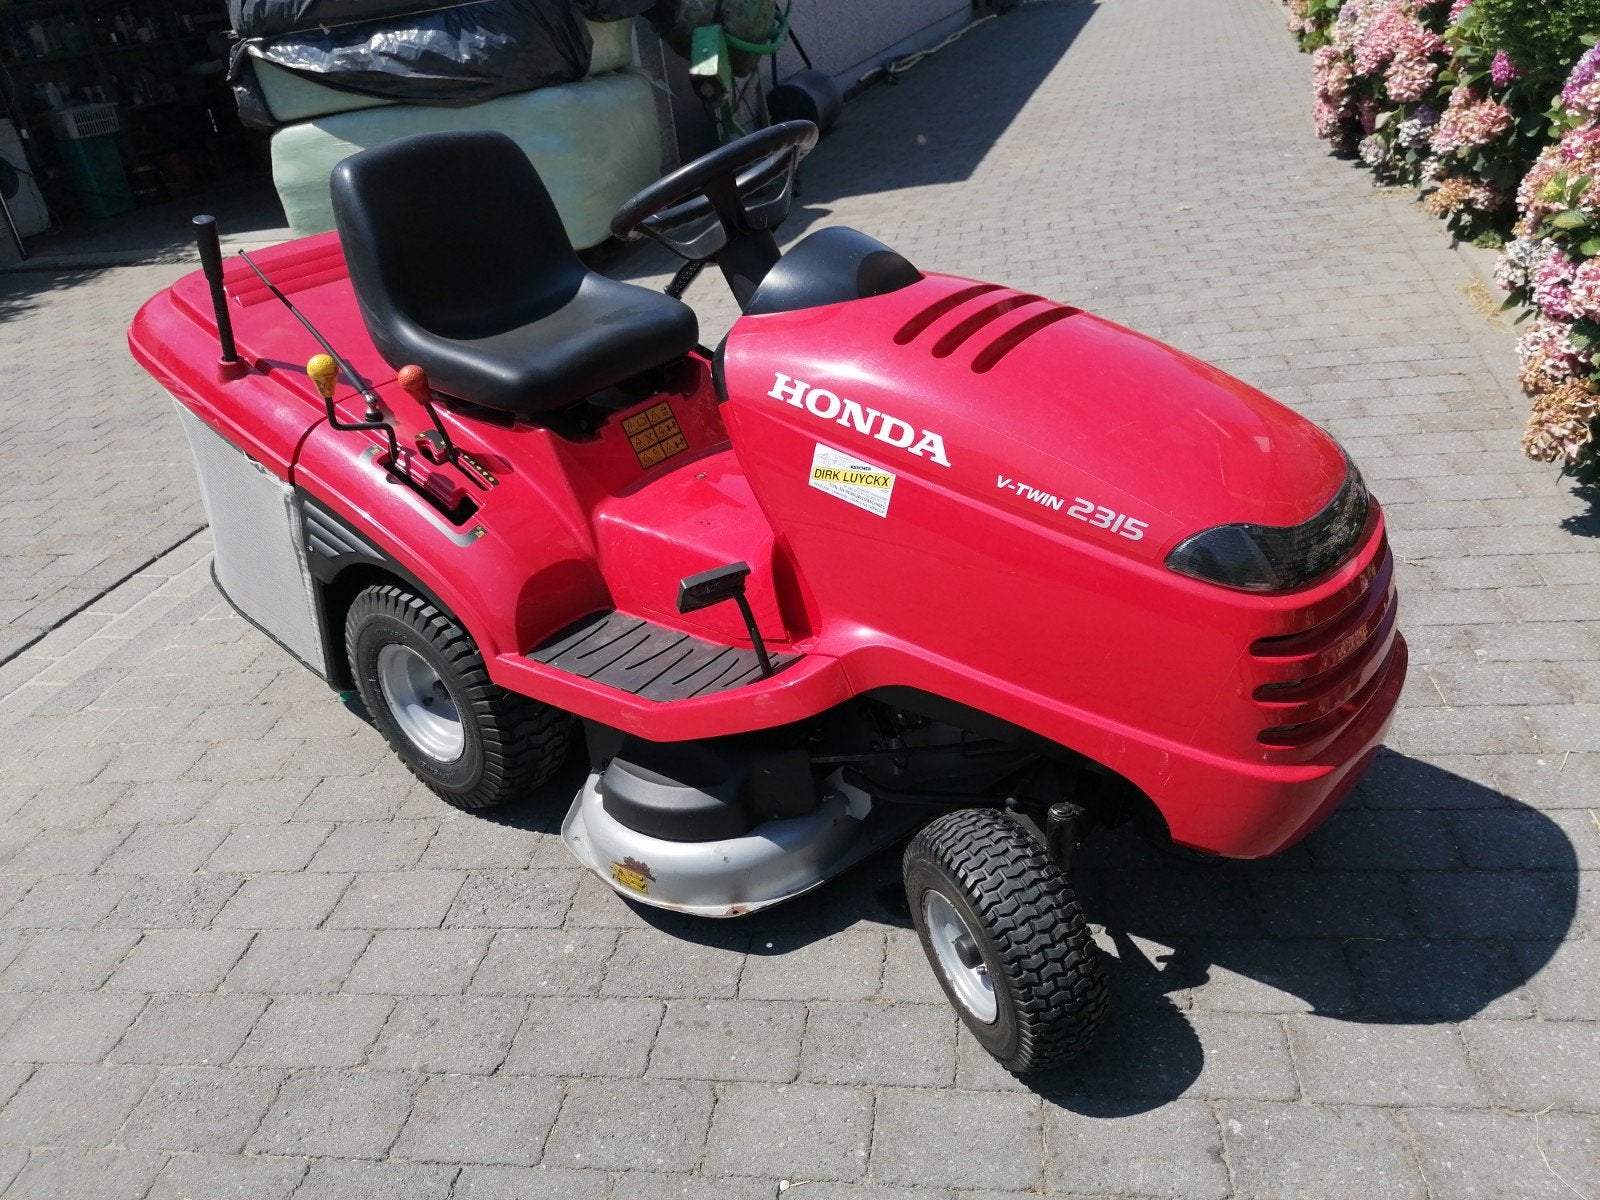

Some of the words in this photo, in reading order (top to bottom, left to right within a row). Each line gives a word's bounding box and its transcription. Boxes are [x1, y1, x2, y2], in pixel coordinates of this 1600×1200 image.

[767, 372, 951, 468] HONDA
[814, 468, 841, 481] DIRK
[843, 472, 890, 487] LUYCKX
[996, 474, 1065, 511] V-TWIN
[1066, 496, 1149, 541] 2315
